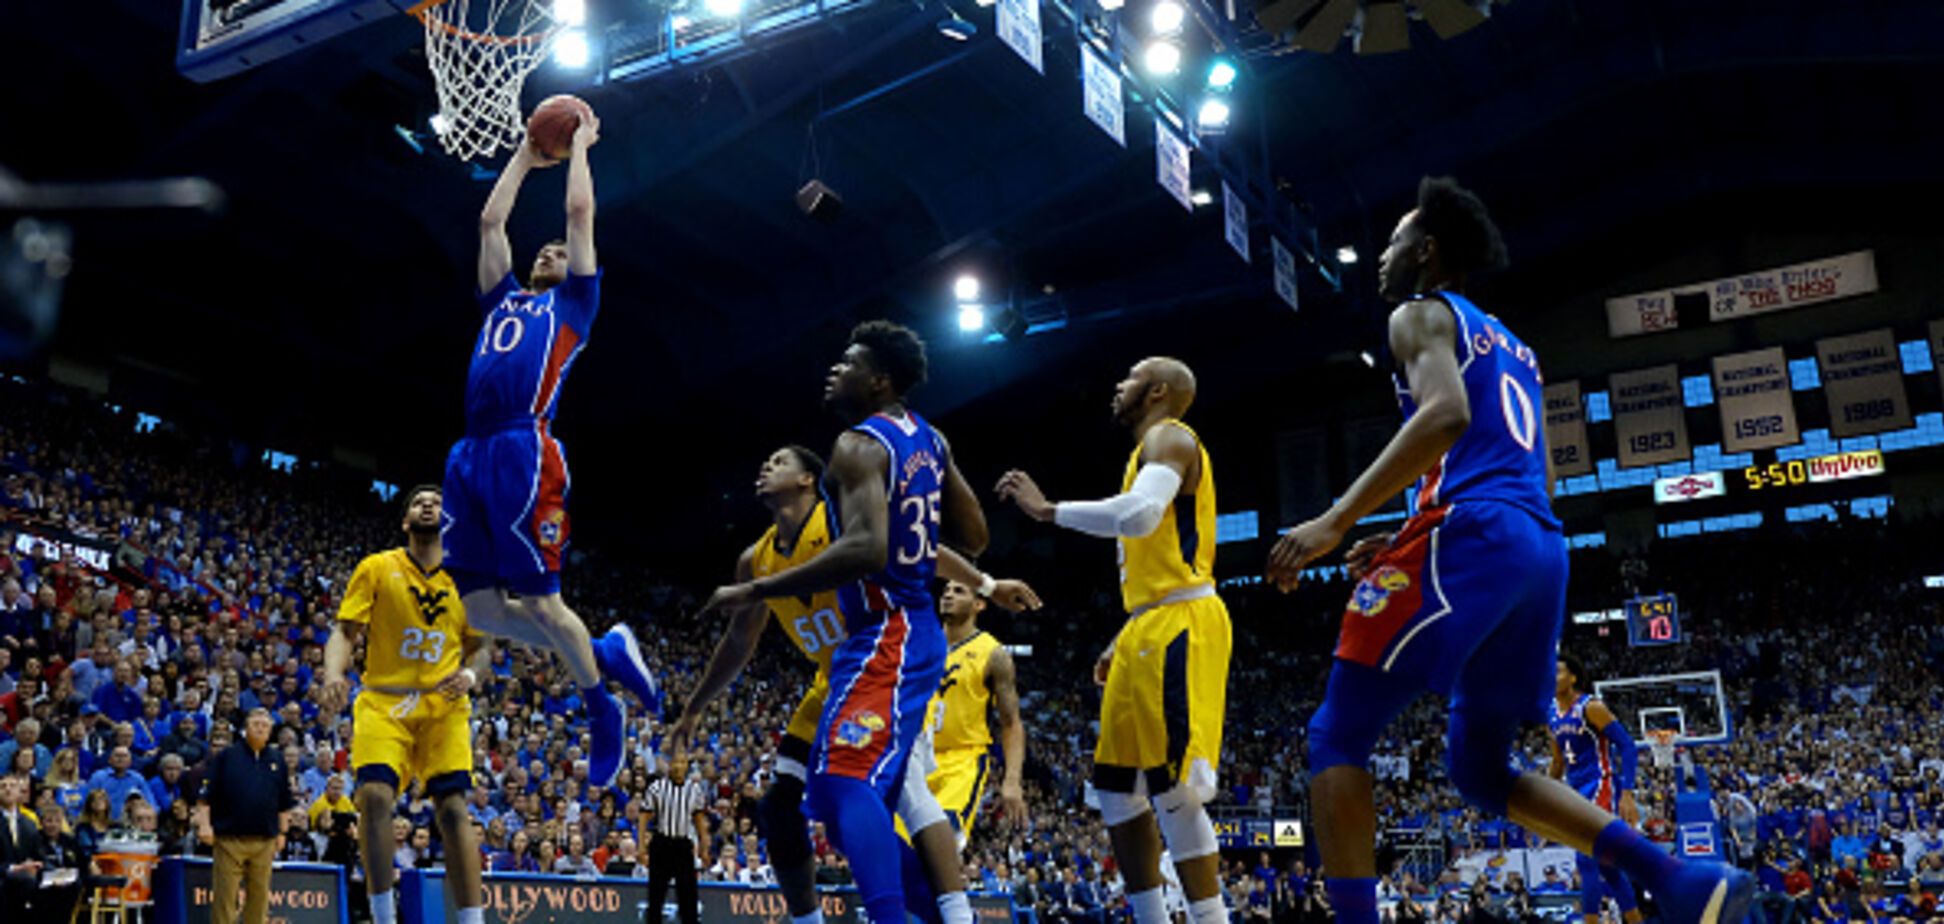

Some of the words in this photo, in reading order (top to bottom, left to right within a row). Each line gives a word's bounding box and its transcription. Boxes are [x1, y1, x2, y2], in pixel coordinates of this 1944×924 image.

[481, 316, 524, 356] 10
[1500, 371, 1536, 453] 0
[1734, 415, 1784, 439] 1952
[1553, 445, 1579, 465] 22
[1629, 432, 1675, 454] 1923
[1746, 461, 1806, 489] 5:50
[896, 490, 941, 565] 35
[793, 607, 848, 654] 50
[400, 627, 446, 664] 23
[194, 887, 329, 909] HWOOD
[481, 884, 621, 913] OLLYWOOD
[730, 893, 847, 916] HOLLYOD
